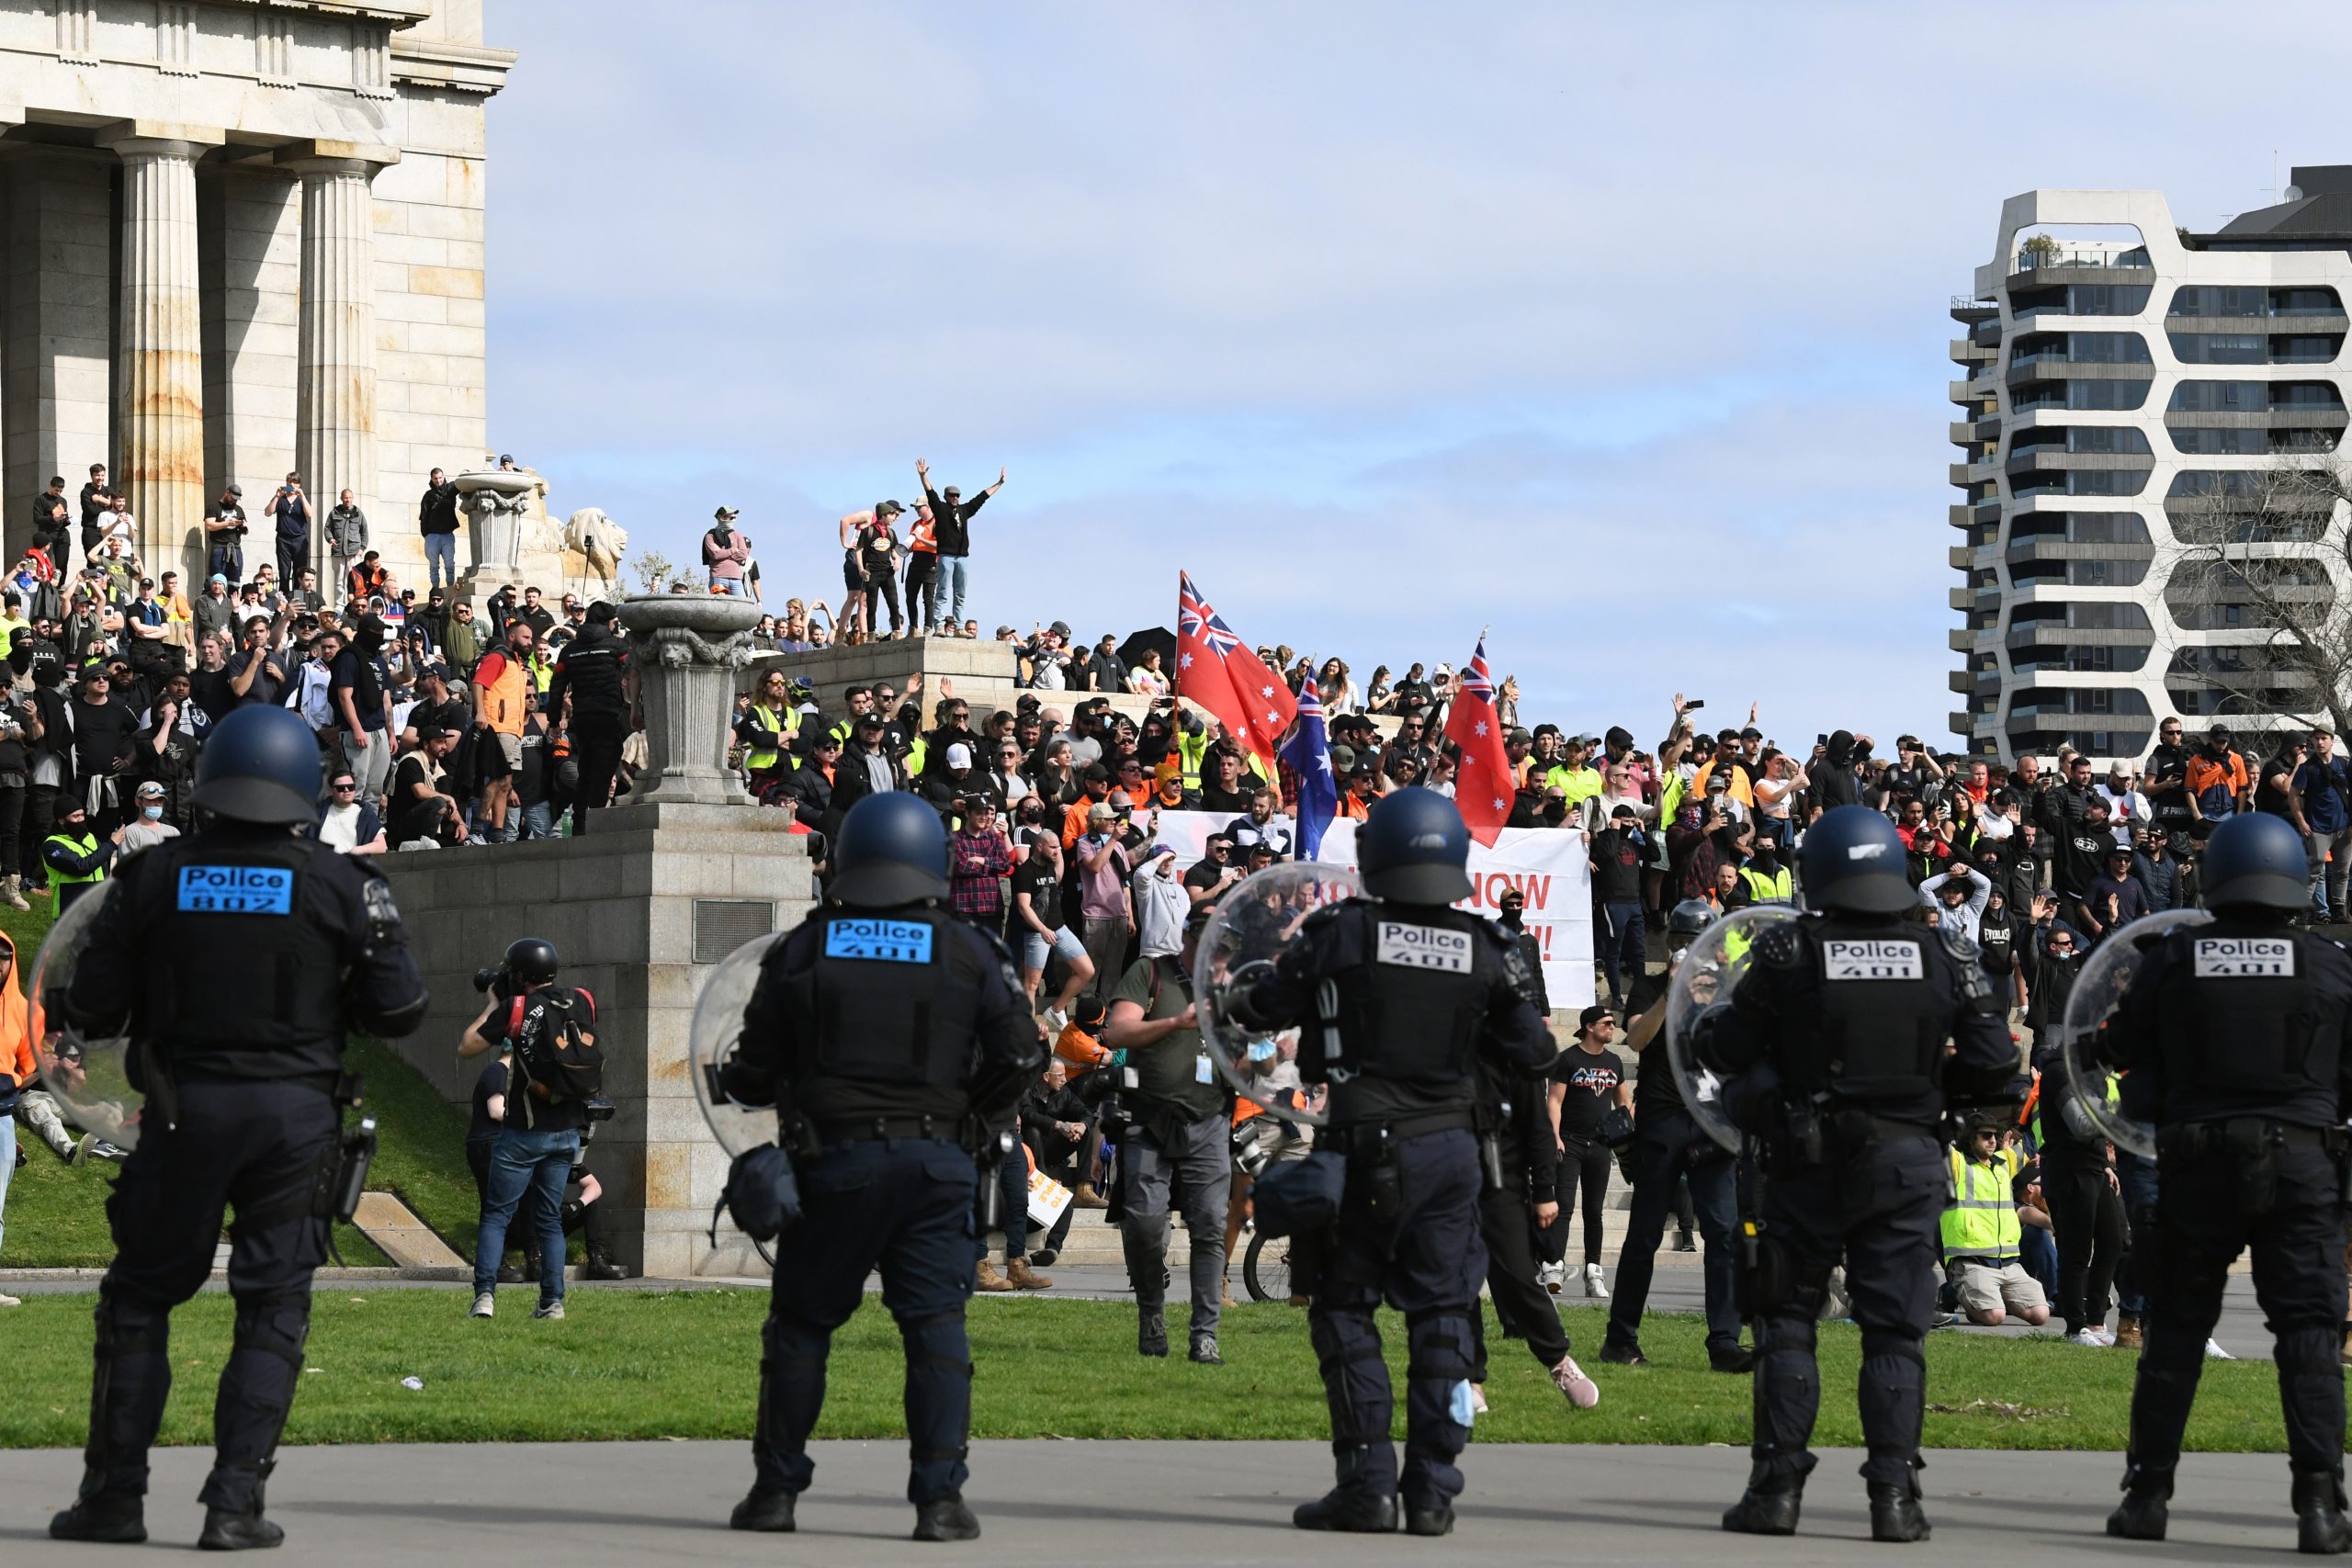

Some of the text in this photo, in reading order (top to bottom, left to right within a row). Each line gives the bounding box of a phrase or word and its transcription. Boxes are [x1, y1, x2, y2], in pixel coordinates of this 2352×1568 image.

[186, 868, 285, 888] Police
[1454, 872, 1552, 910] NOW
[834, 921, 924, 941] Police
[1385, 925, 1465, 950] Police
[841, 942, 917, 960] 401
[1830, 942, 1913, 957] Police
[2201, 941, 2286, 955] Police
[1391, 952, 1460, 969] 401
[1840, 965, 1910, 977] 401
[2209, 964, 2281, 975] 401
[520, 1019, 532, 1036] FEEL
